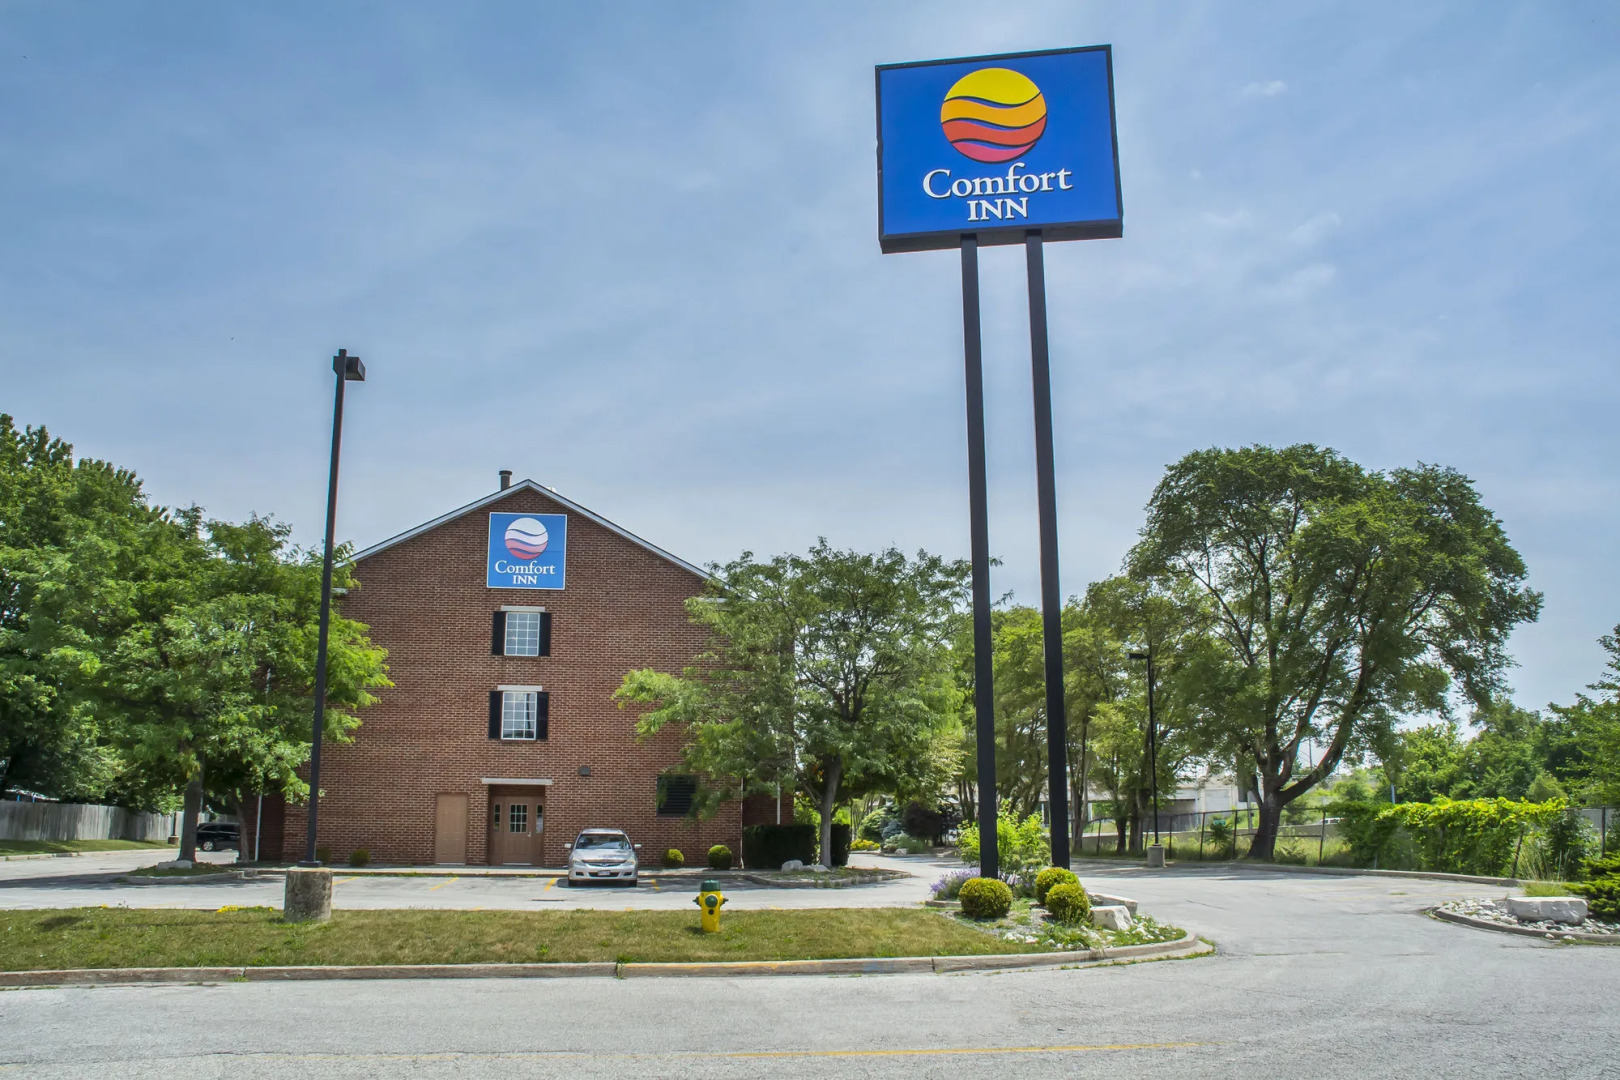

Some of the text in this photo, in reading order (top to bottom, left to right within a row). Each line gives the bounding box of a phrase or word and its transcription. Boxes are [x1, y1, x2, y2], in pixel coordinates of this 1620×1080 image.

[923, 162, 1073, 199] Comfort
[967, 197, 1028, 221] INN
[494, 560, 556, 574] Comfort
[513, 575, 537, 585] INN
